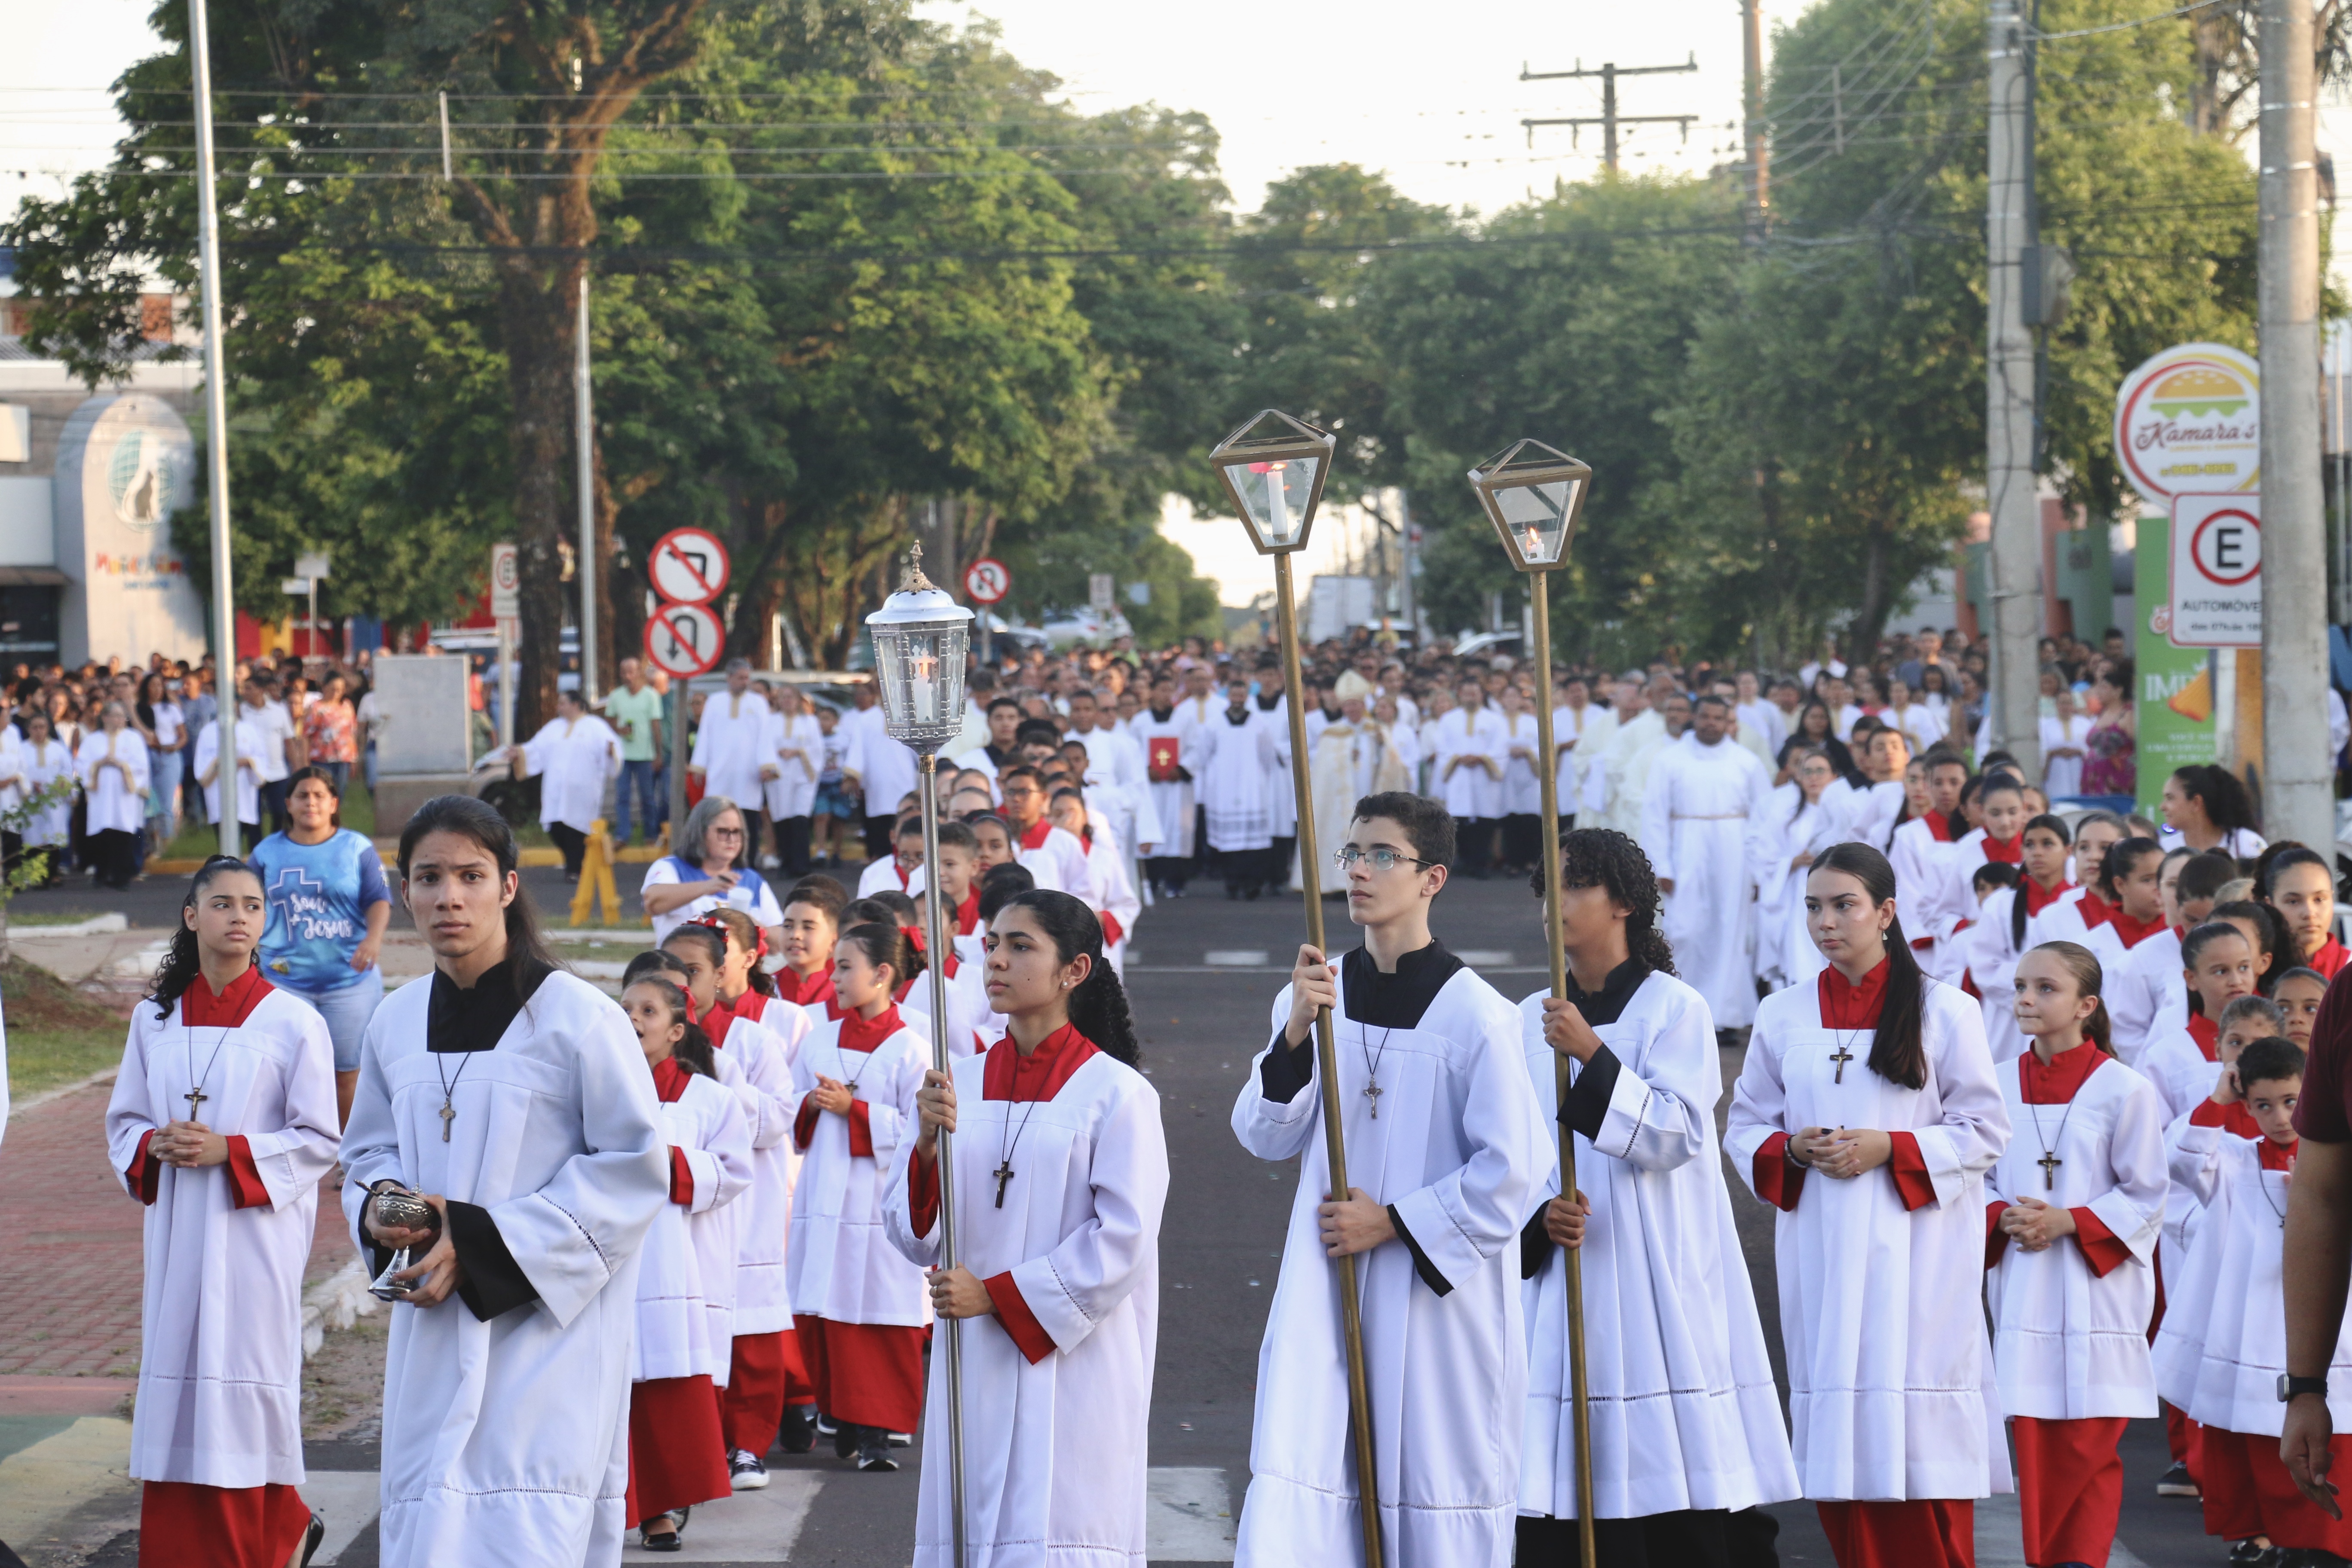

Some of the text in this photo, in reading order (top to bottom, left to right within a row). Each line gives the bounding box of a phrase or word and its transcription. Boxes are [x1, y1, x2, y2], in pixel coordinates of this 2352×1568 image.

[2136, 421, 2256, 450] Kamara's
[2216, 528, 2242, 569] E
[302, 916, 353, 940] Jesus
